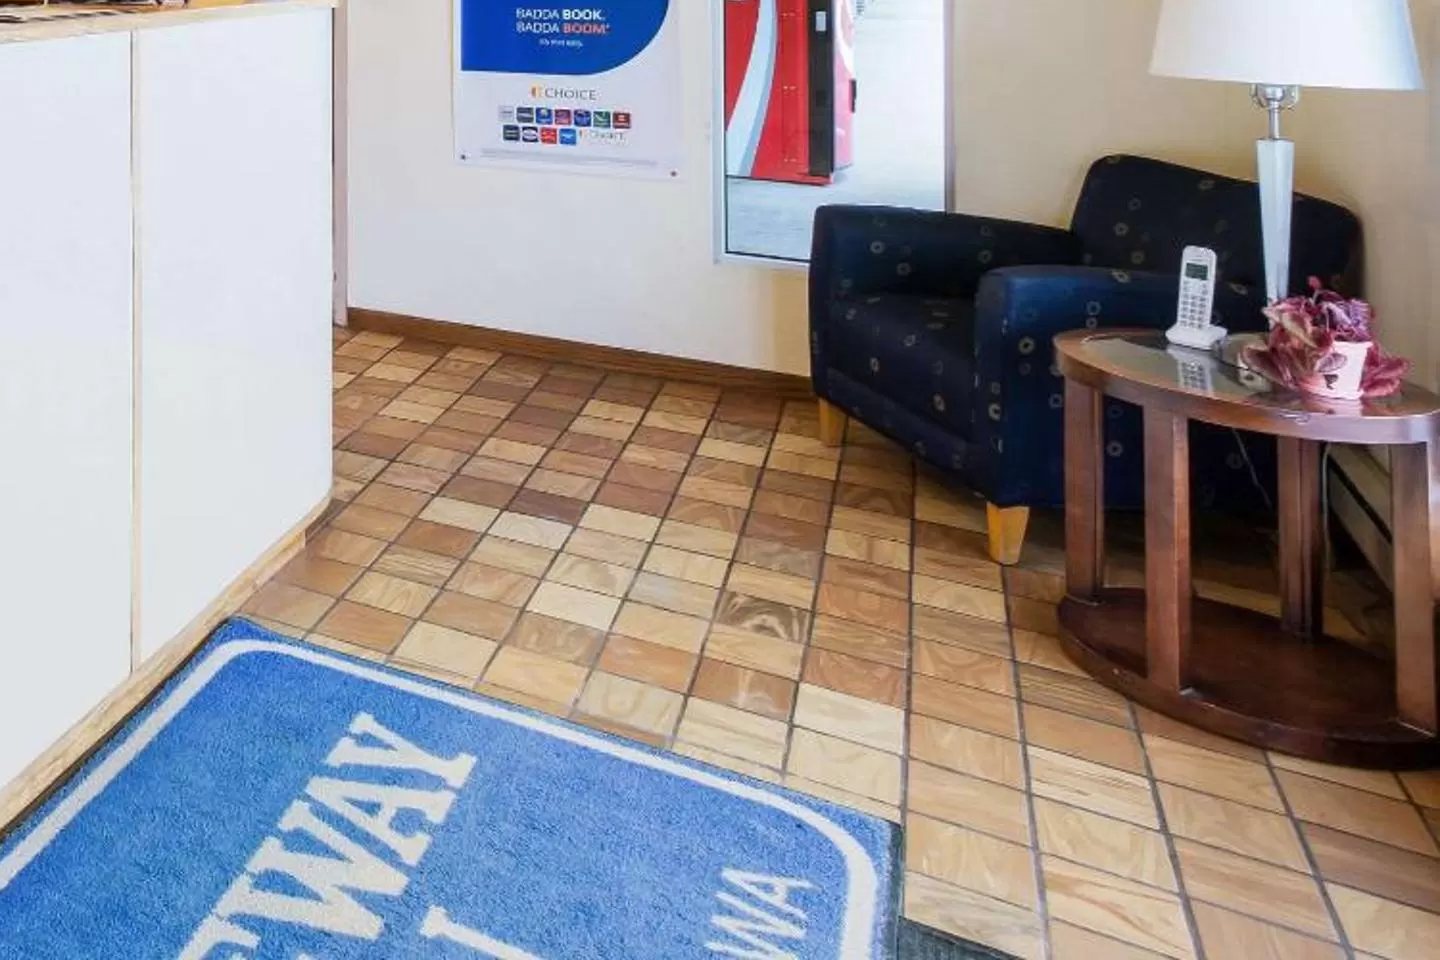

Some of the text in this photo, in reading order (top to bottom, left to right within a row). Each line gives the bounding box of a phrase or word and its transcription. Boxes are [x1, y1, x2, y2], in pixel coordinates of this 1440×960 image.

[515, 7, 560, 20] BADDA
[515, 21, 560, 34] BADDA
[544, 87, 598, 101] CHOICE
